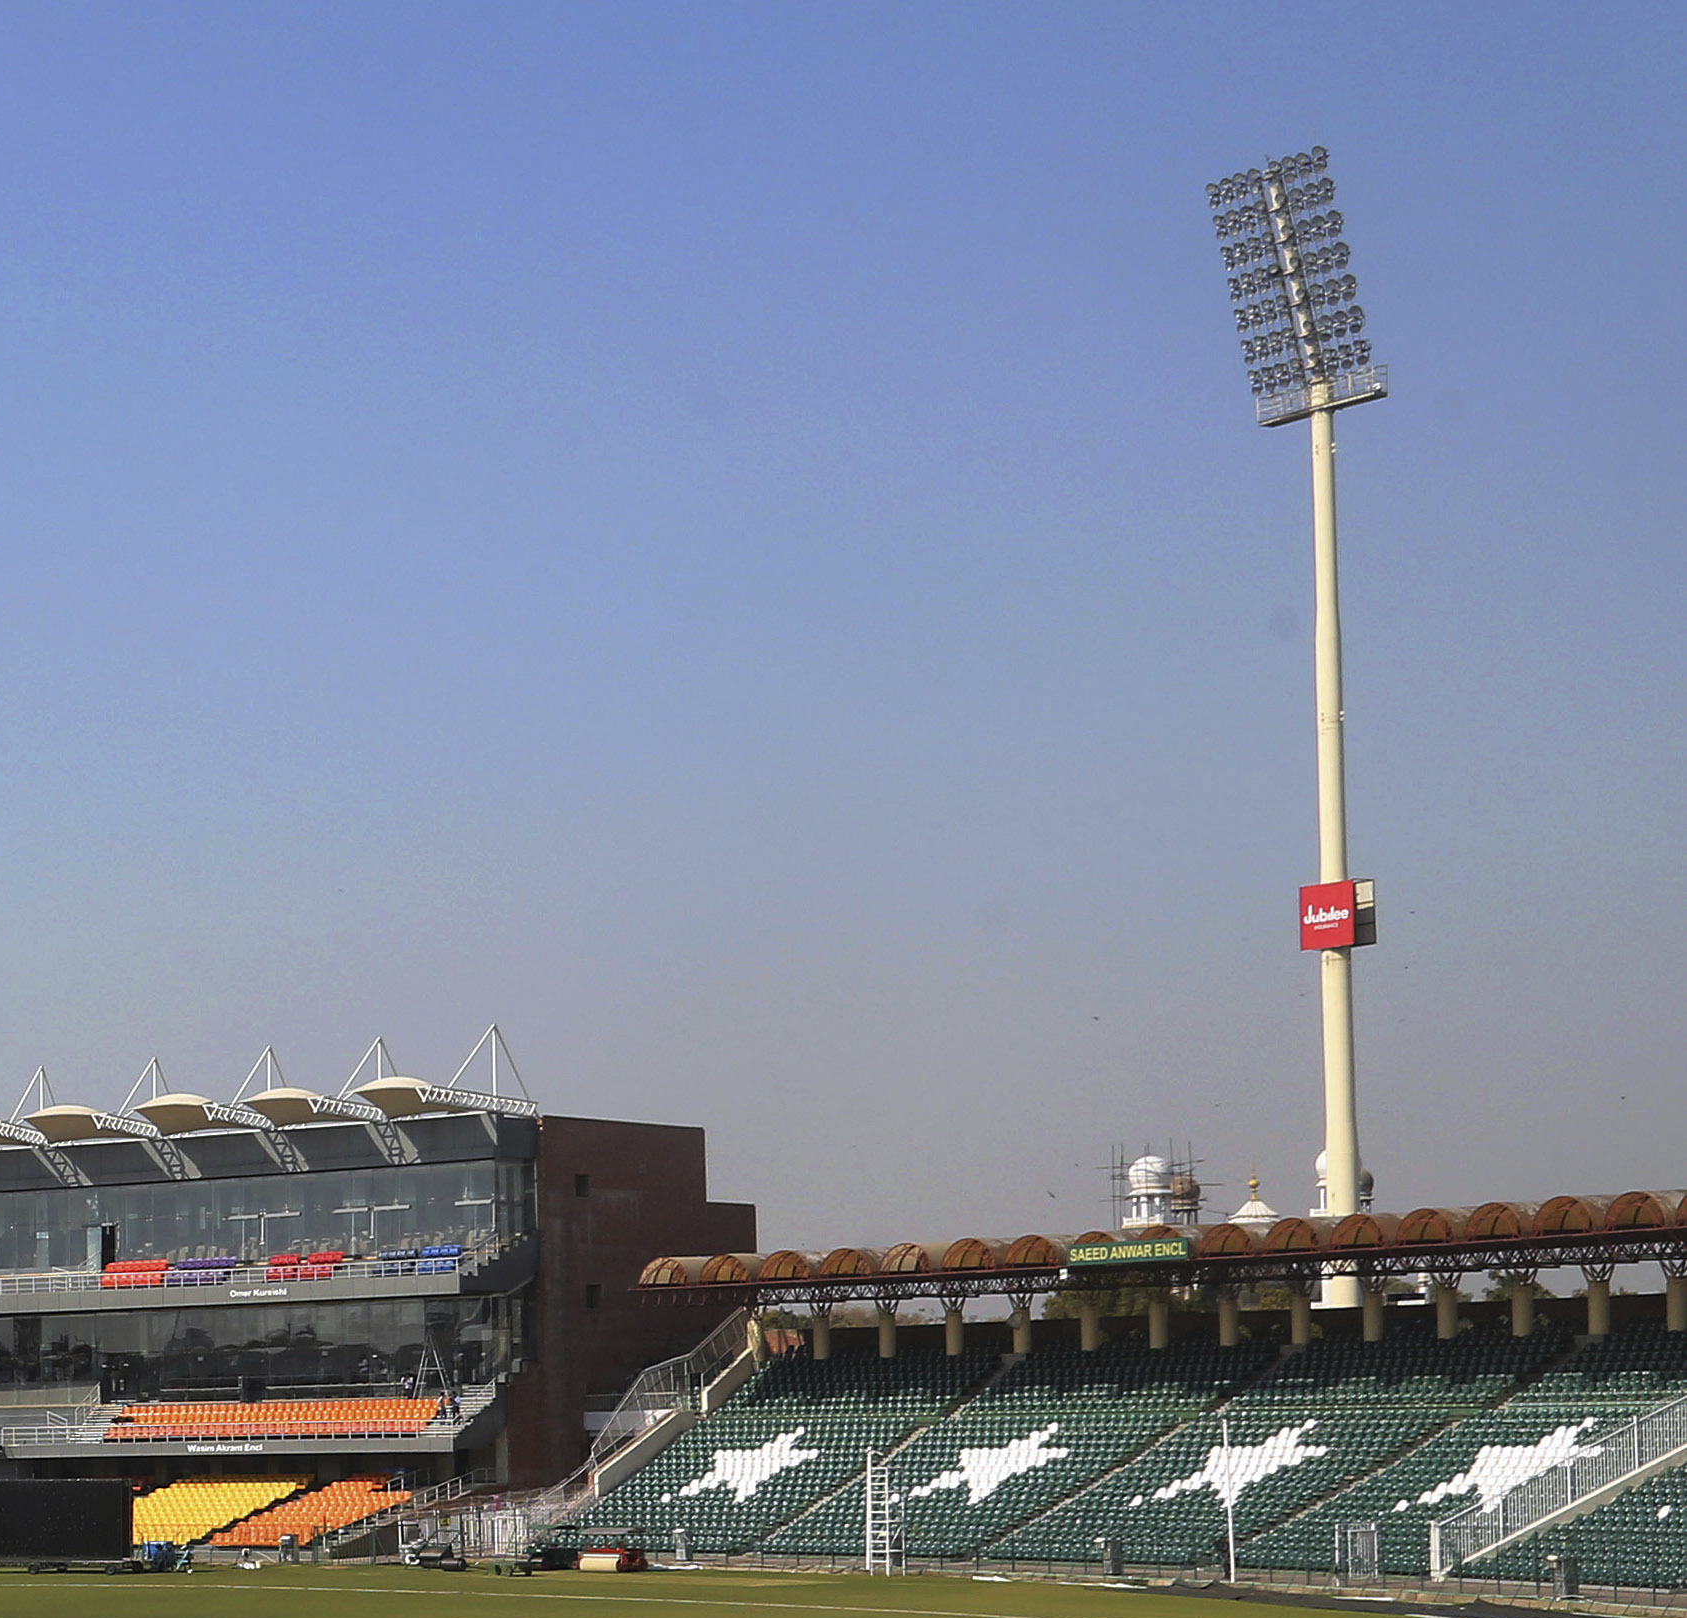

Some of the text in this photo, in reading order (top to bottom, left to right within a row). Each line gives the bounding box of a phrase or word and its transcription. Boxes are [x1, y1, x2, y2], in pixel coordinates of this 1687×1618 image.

[1070, 1242, 1186, 1261] SAEED ANWAR ENCL
[187, 1443, 263, 1452] Wasim Akram Encl
